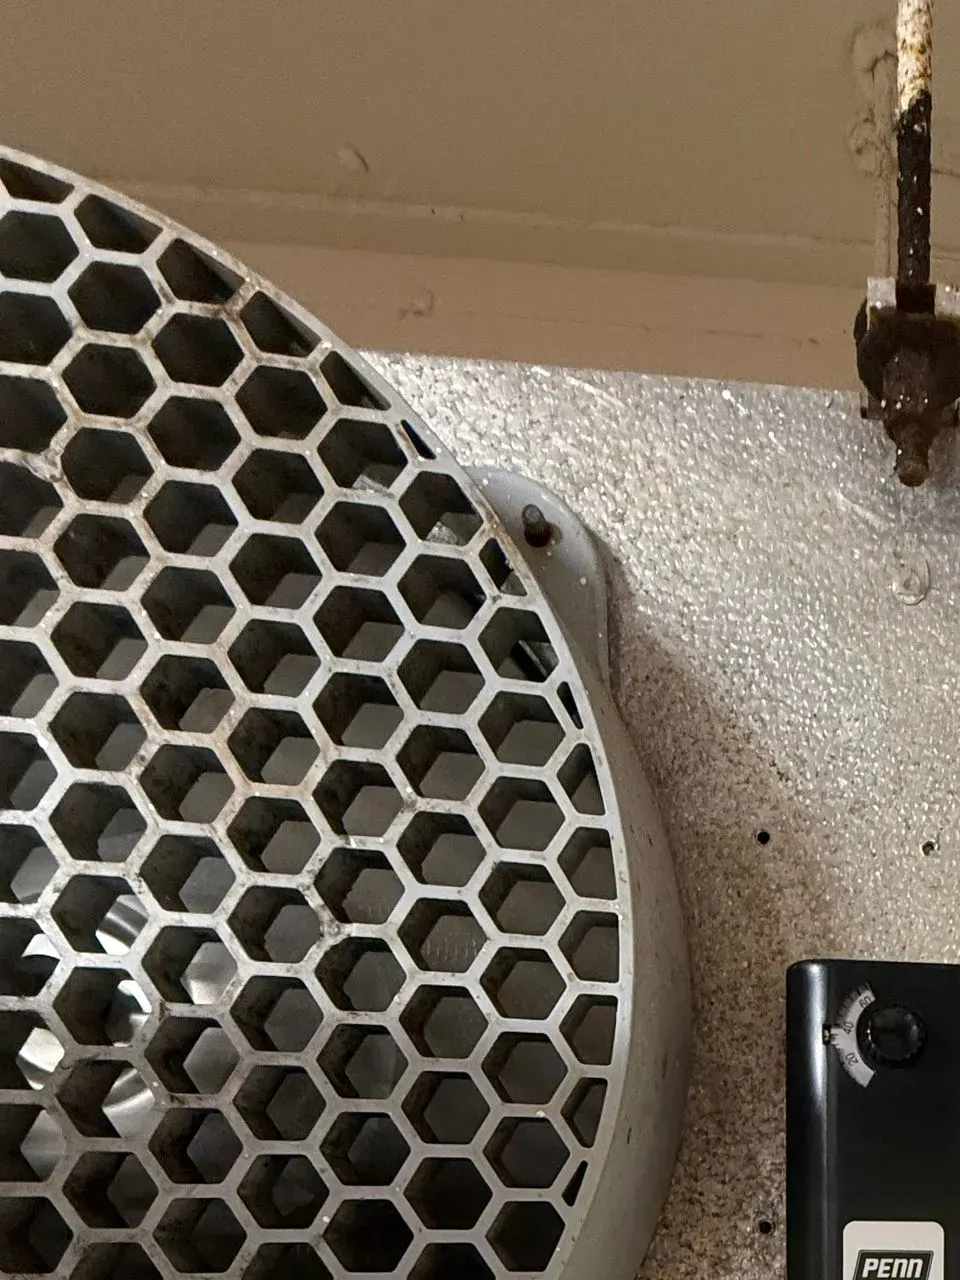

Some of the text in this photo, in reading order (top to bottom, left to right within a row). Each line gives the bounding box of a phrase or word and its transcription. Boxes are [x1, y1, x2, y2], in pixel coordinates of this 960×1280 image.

[858, 995, 873, 1009] 60
[843, 1021, 855, 1035] 40
[845, 1052, 859, 1067] 20
[861, 1258, 924, 1279] PENN
